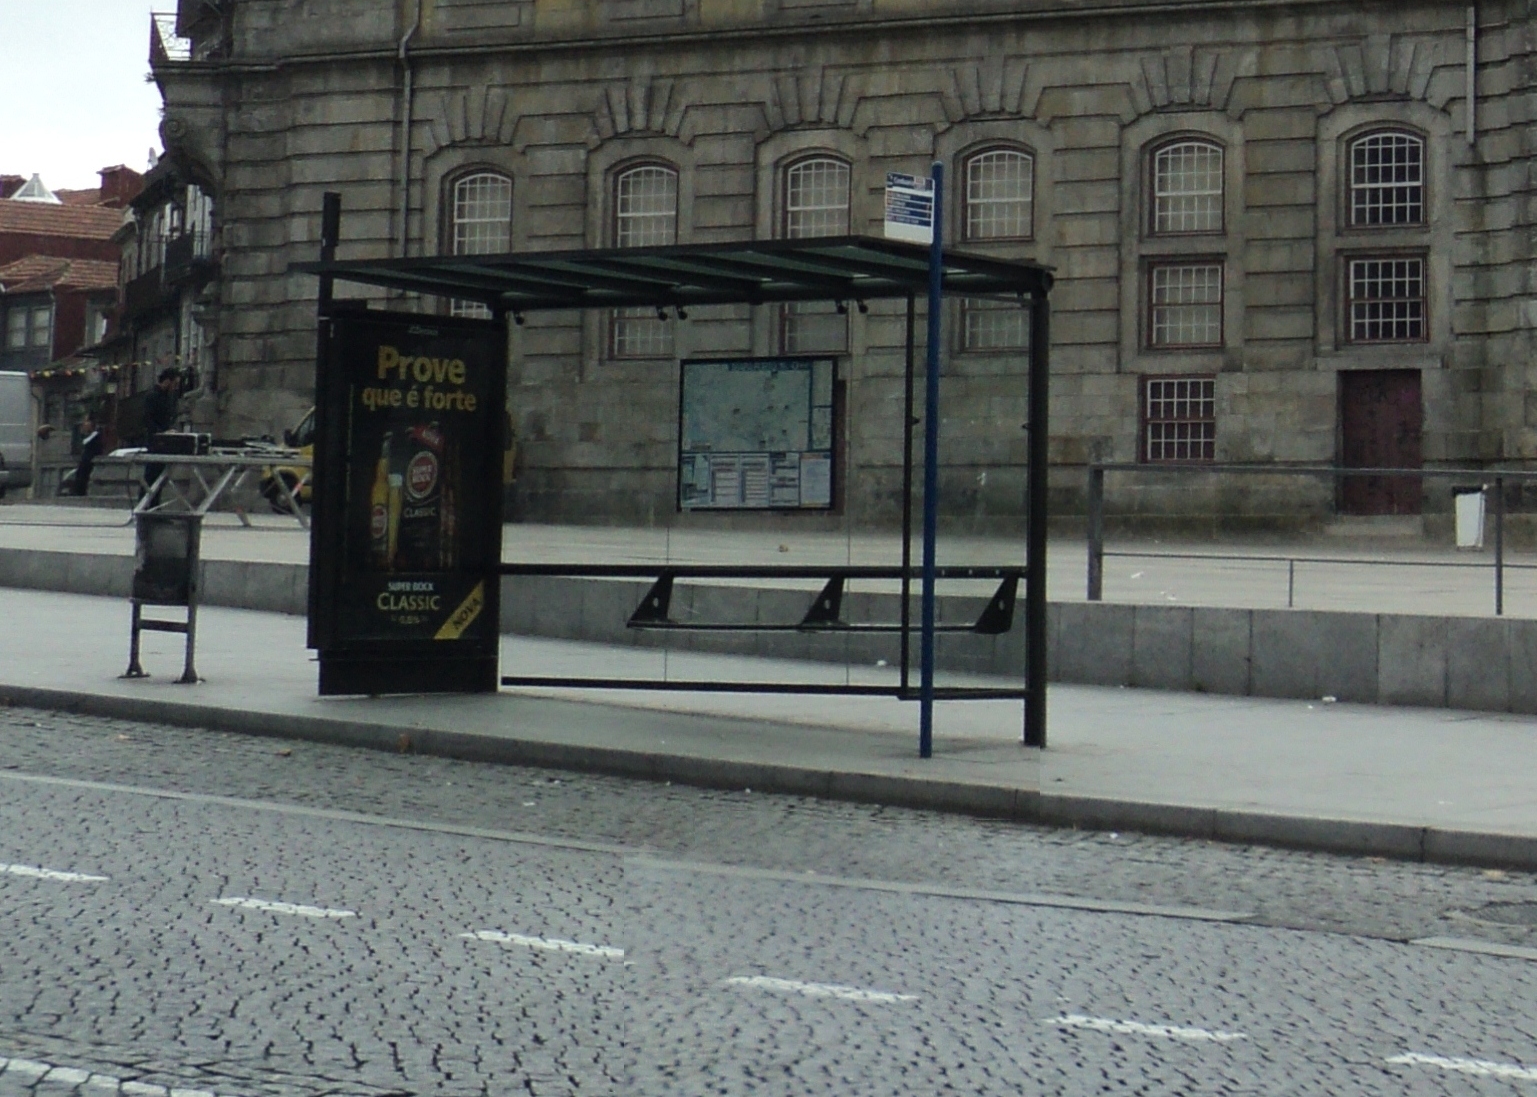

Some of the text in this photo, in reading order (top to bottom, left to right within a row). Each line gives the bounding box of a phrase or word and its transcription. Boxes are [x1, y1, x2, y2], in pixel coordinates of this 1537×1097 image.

[377, 345, 466, 384] Prove
[362, 384, 477, 412] que é forte
[388, 582, 434, 591] SUPER BOCK
[377, 592, 440, 610] CLASSIC
[453, 598, 480, 631] NOVA
